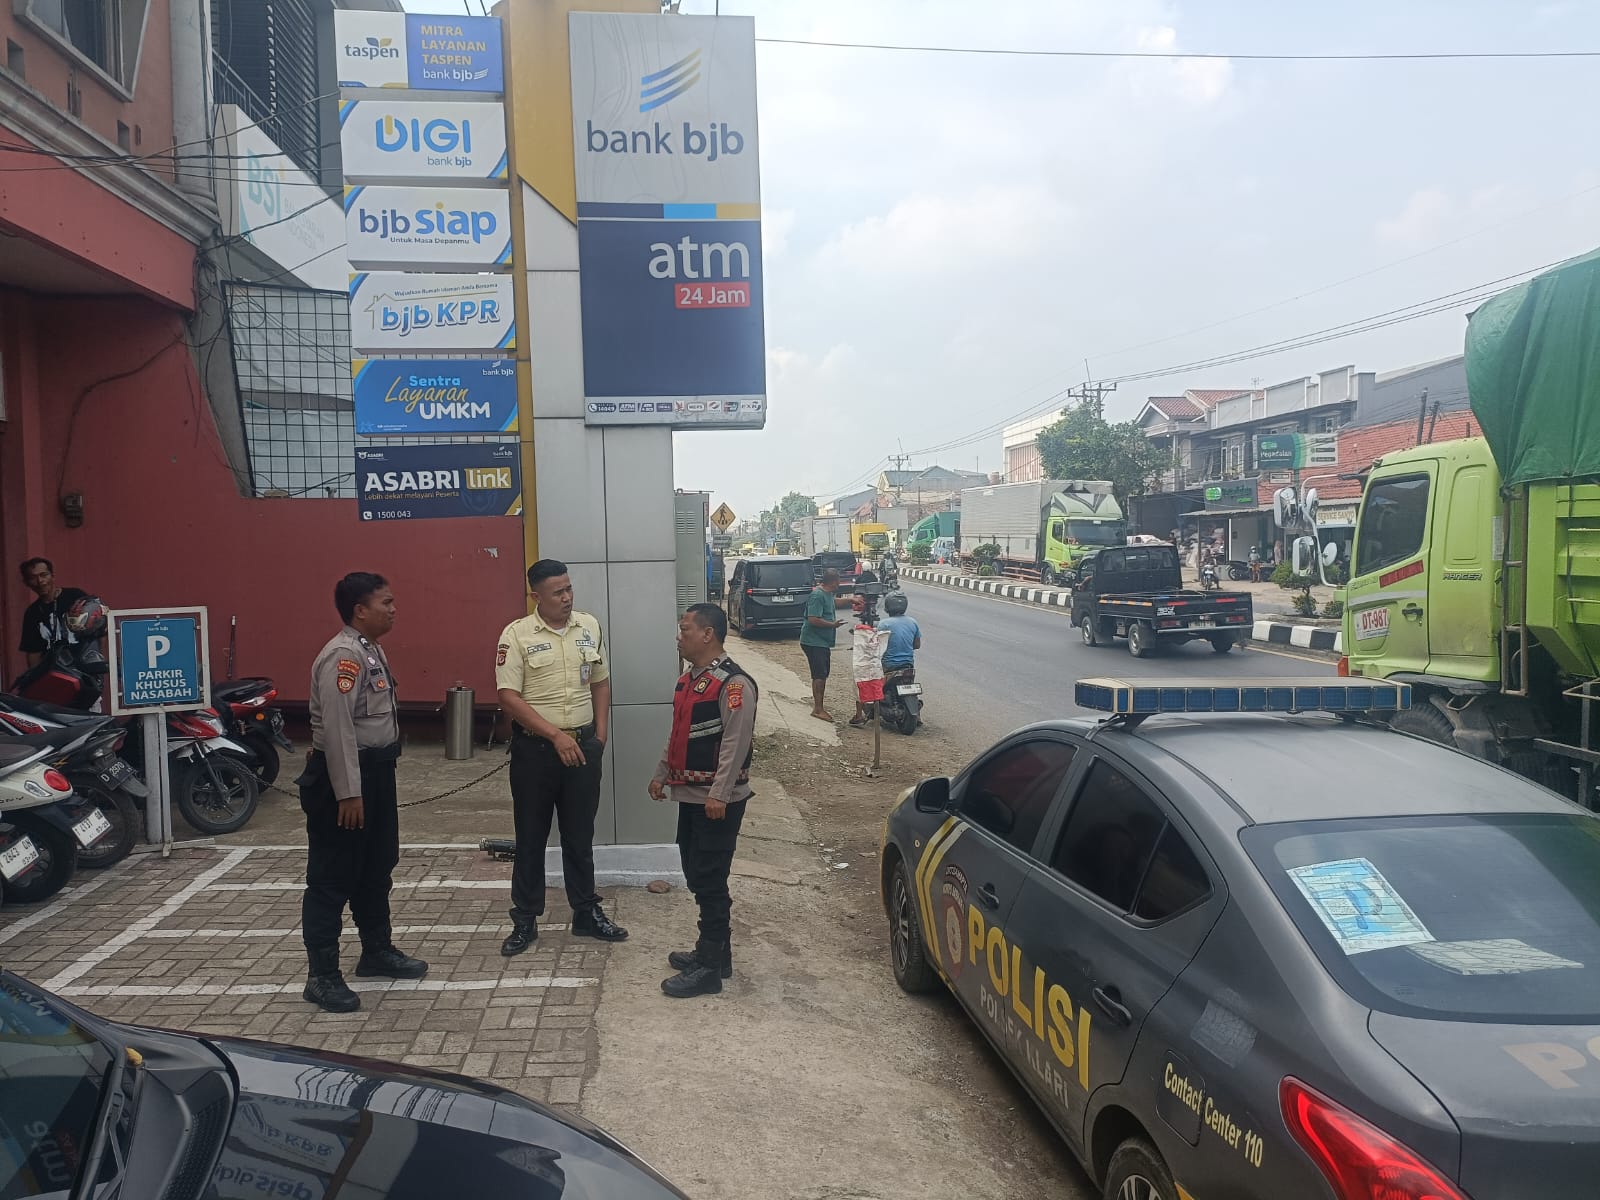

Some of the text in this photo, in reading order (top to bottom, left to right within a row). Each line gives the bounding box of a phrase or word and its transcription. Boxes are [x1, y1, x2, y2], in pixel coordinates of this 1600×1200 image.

[421, 24, 464, 38] MITRA
[344, 43, 400, 61] taspen
[421, 40, 487, 53] LAYANAN
[422, 53, 473, 66] TASPEN
[423, 68, 473, 82] bank bjb
[587, 119, 745, 162] bank bjb
[427, 156, 472, 169] bank bjb
[359, 207, 410, 239] bjb
[414, 201, 498, 245] siap
[390, 236, 413, 244] Untuk
[434, 237, 470, 246] Depanmu
[647, 234, 751, 280] atm
[679, 285, 746, 305] 24 Jam
[381, 304, 433, 337] bjb
[435, 298, 501, 328] KPR
[481, 368, 515, 377] bank bjb
[408, 374, 462, 387] Sentra
[384, 375, 470, 414] Layanan
[418, 401, 491, 420] UMKM
[364, 467, 511, 493] ASABRI link
[364, 490, 460, 501] Lebih dekat melayani Peserta
[377, 510, 411, 519] 1500 043
[1442, 572, 1483, 581] RANGER
[1361, 607, 1388, 631] DT-987
[147, 634, 171, 669] P
[138, 669, 184, 681] PARKIR
[135, 678, 187, 690] KHUSUS
[130, 687, 192, 700] NASABAH
[967, 902, 1092, 1093] POLISI
[1164, 1061, 1264, 1169] Contact Center 110
